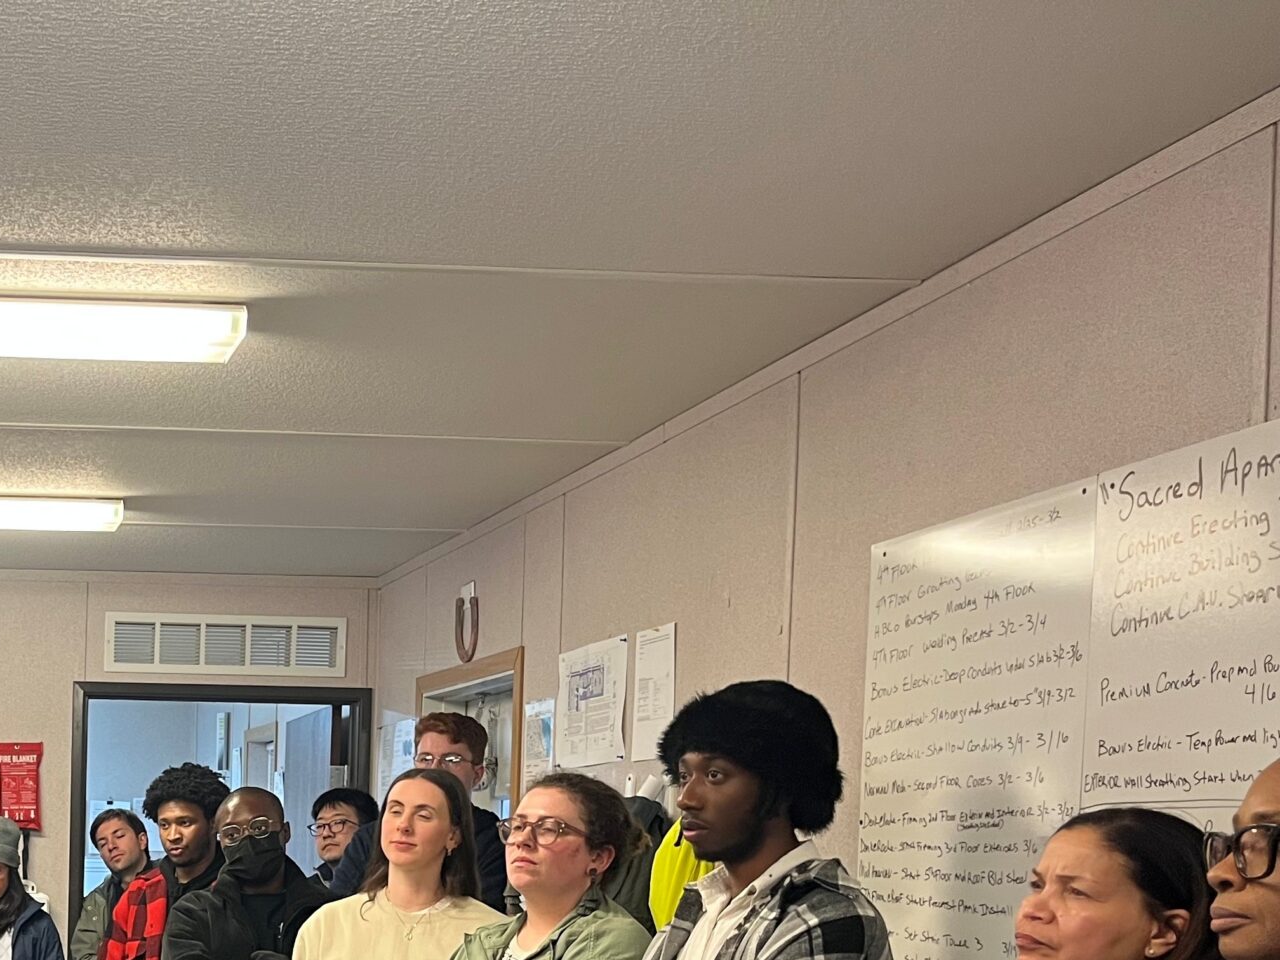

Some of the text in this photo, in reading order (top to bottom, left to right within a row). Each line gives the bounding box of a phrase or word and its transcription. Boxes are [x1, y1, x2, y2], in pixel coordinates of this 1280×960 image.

[1118, 456, 1203, 521] Sacred
[1117, 510, 1270, 564] Continue Erecting
[1114, 570, 1181, 599] Continue
[1188, 545, 1261, 575] Building
[1111, 603, 1174, 637] Continue
[0, 755, 12, 763] FIRE
[13, 754, 37, 763] BLANKET
